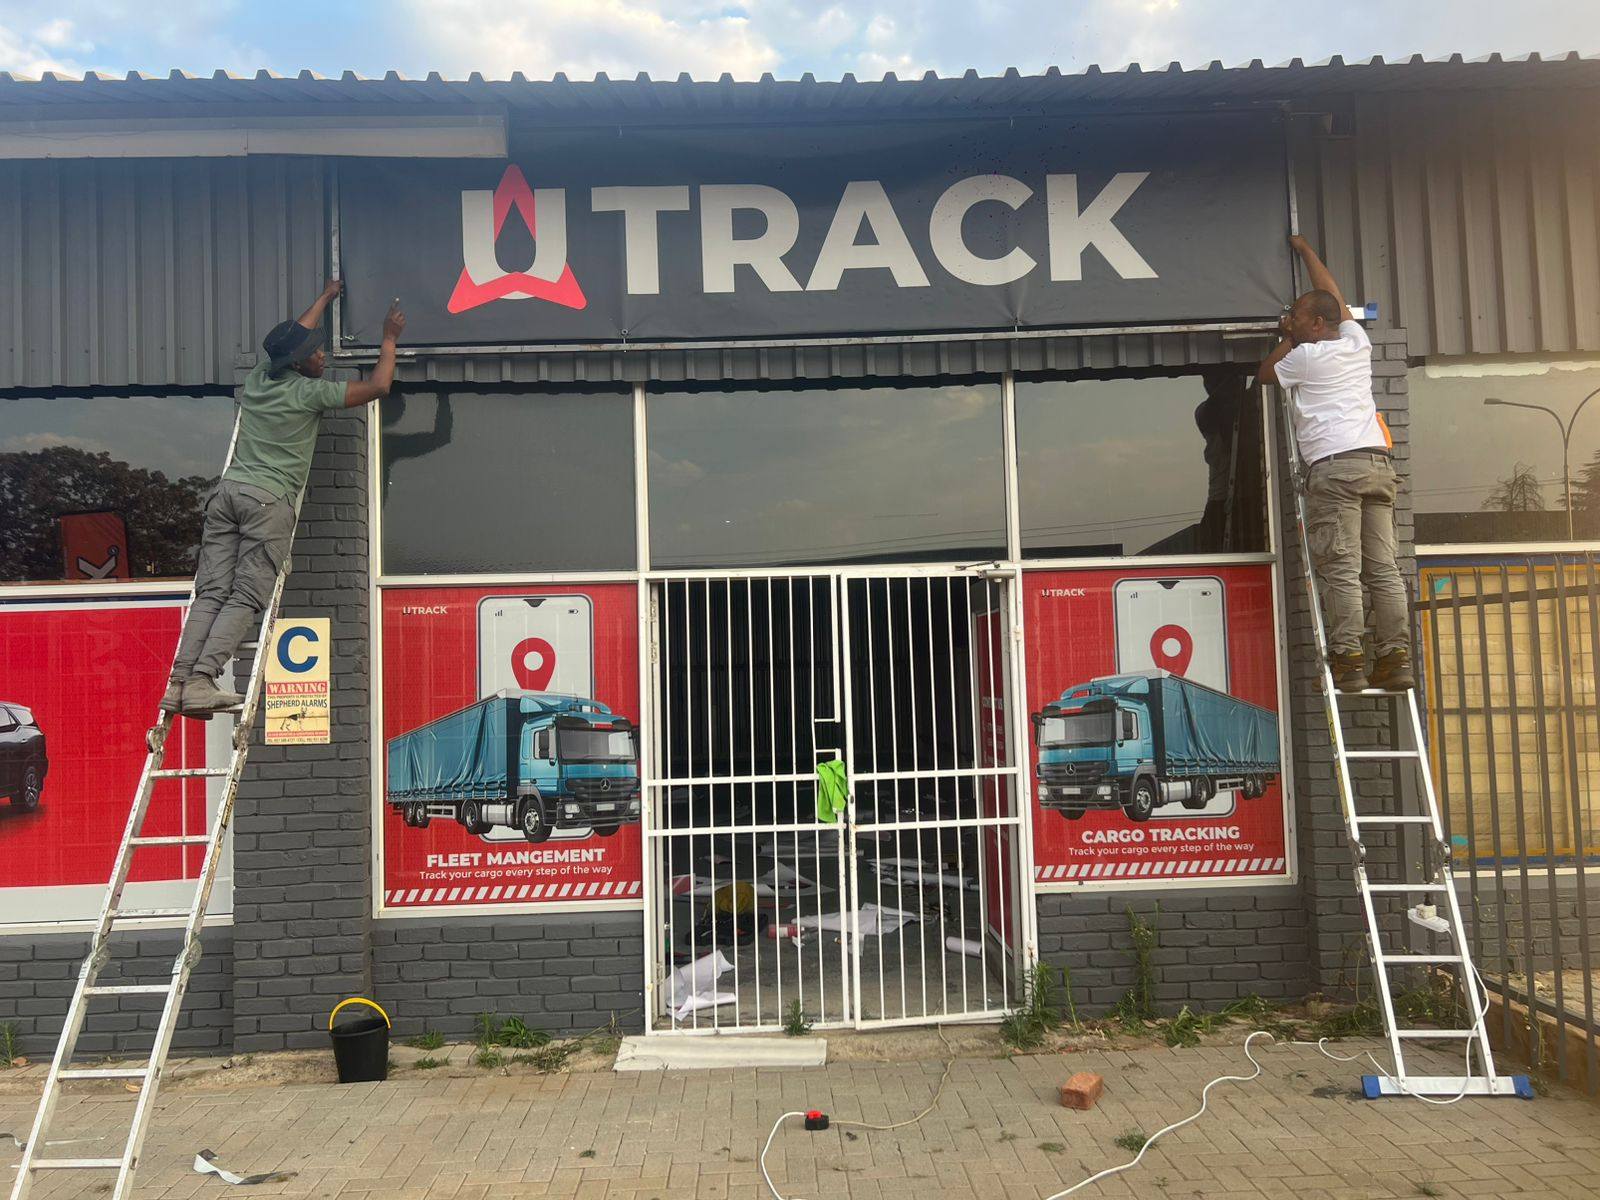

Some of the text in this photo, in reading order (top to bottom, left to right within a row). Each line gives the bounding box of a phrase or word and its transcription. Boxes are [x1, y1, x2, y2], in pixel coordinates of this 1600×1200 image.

[448, 163, 1159, 313] UTRACK
[277, 626, 319, 673] C
[268, 683, 326, 694] WARNING
[267, 699, 328, 710] SHEPHERD ALARMS
[1081, 826, 1240, 844] CARGO TRACKING
[426, 847, 606, 868] FLEET MANGEMENT
[1068, 842, 1255, 857] Track your cargo every step of the way
[419, 865, 613, 881] Track your cargo every step of the way
